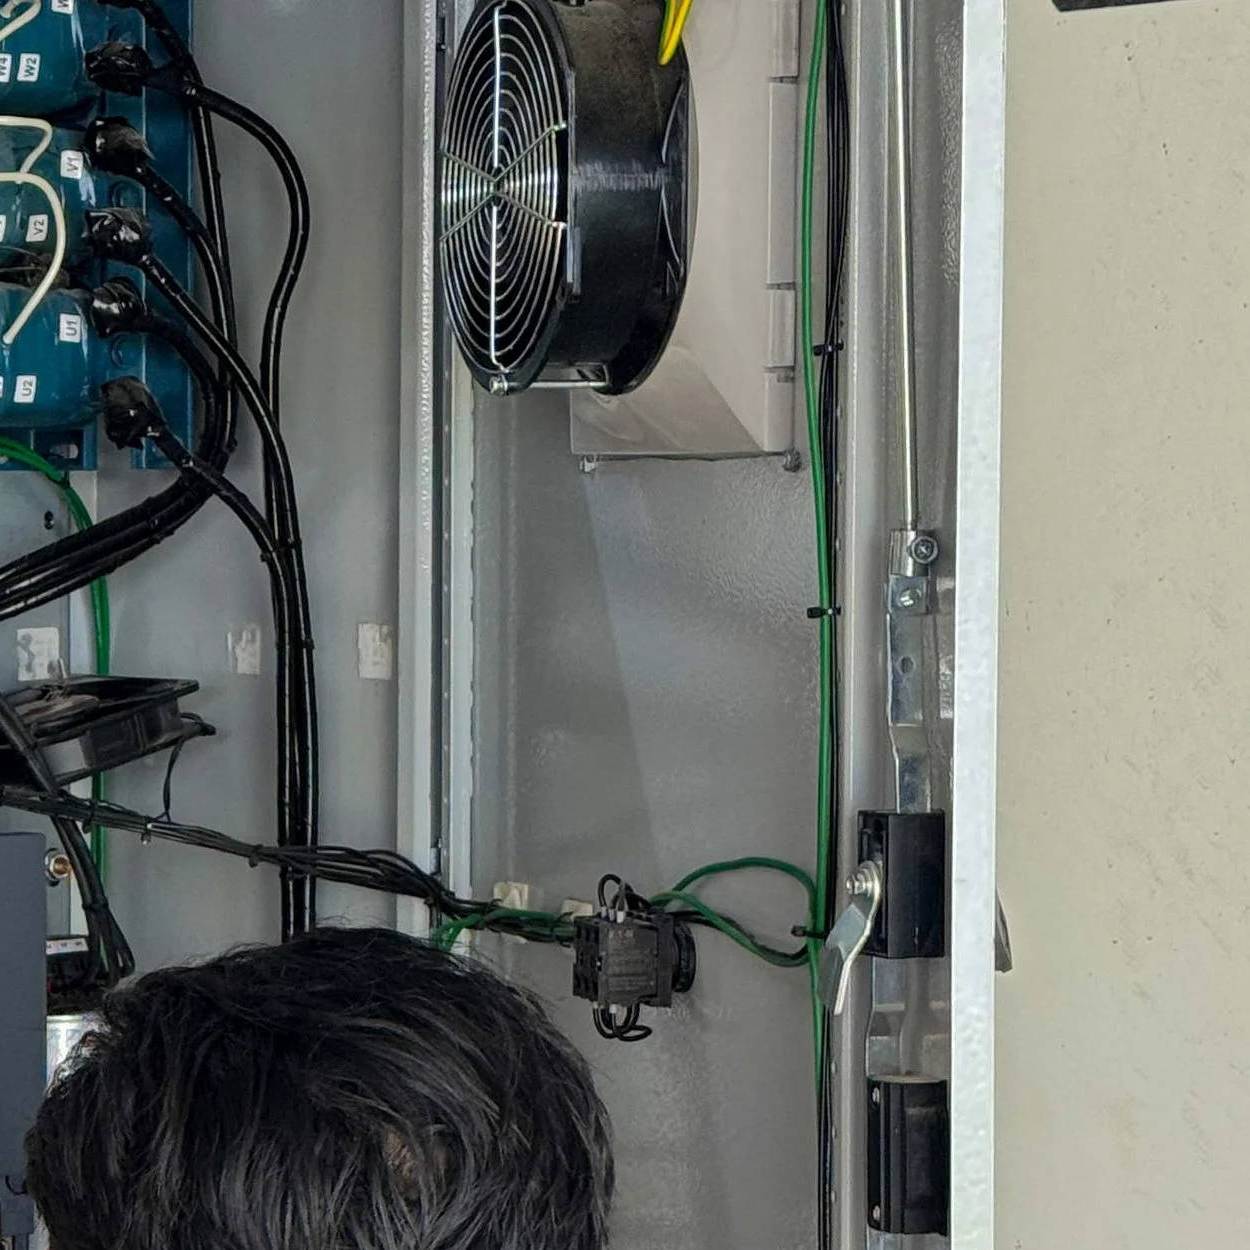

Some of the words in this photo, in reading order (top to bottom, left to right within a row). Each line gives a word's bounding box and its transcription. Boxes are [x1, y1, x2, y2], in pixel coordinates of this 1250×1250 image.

[23, 58, 37, 77] W2
[67, 157, 79, 173] V1
[33, 219, 45, 236] V2
[65, 320, 78, 337] U1
[21, 380, 34, 397] U2
